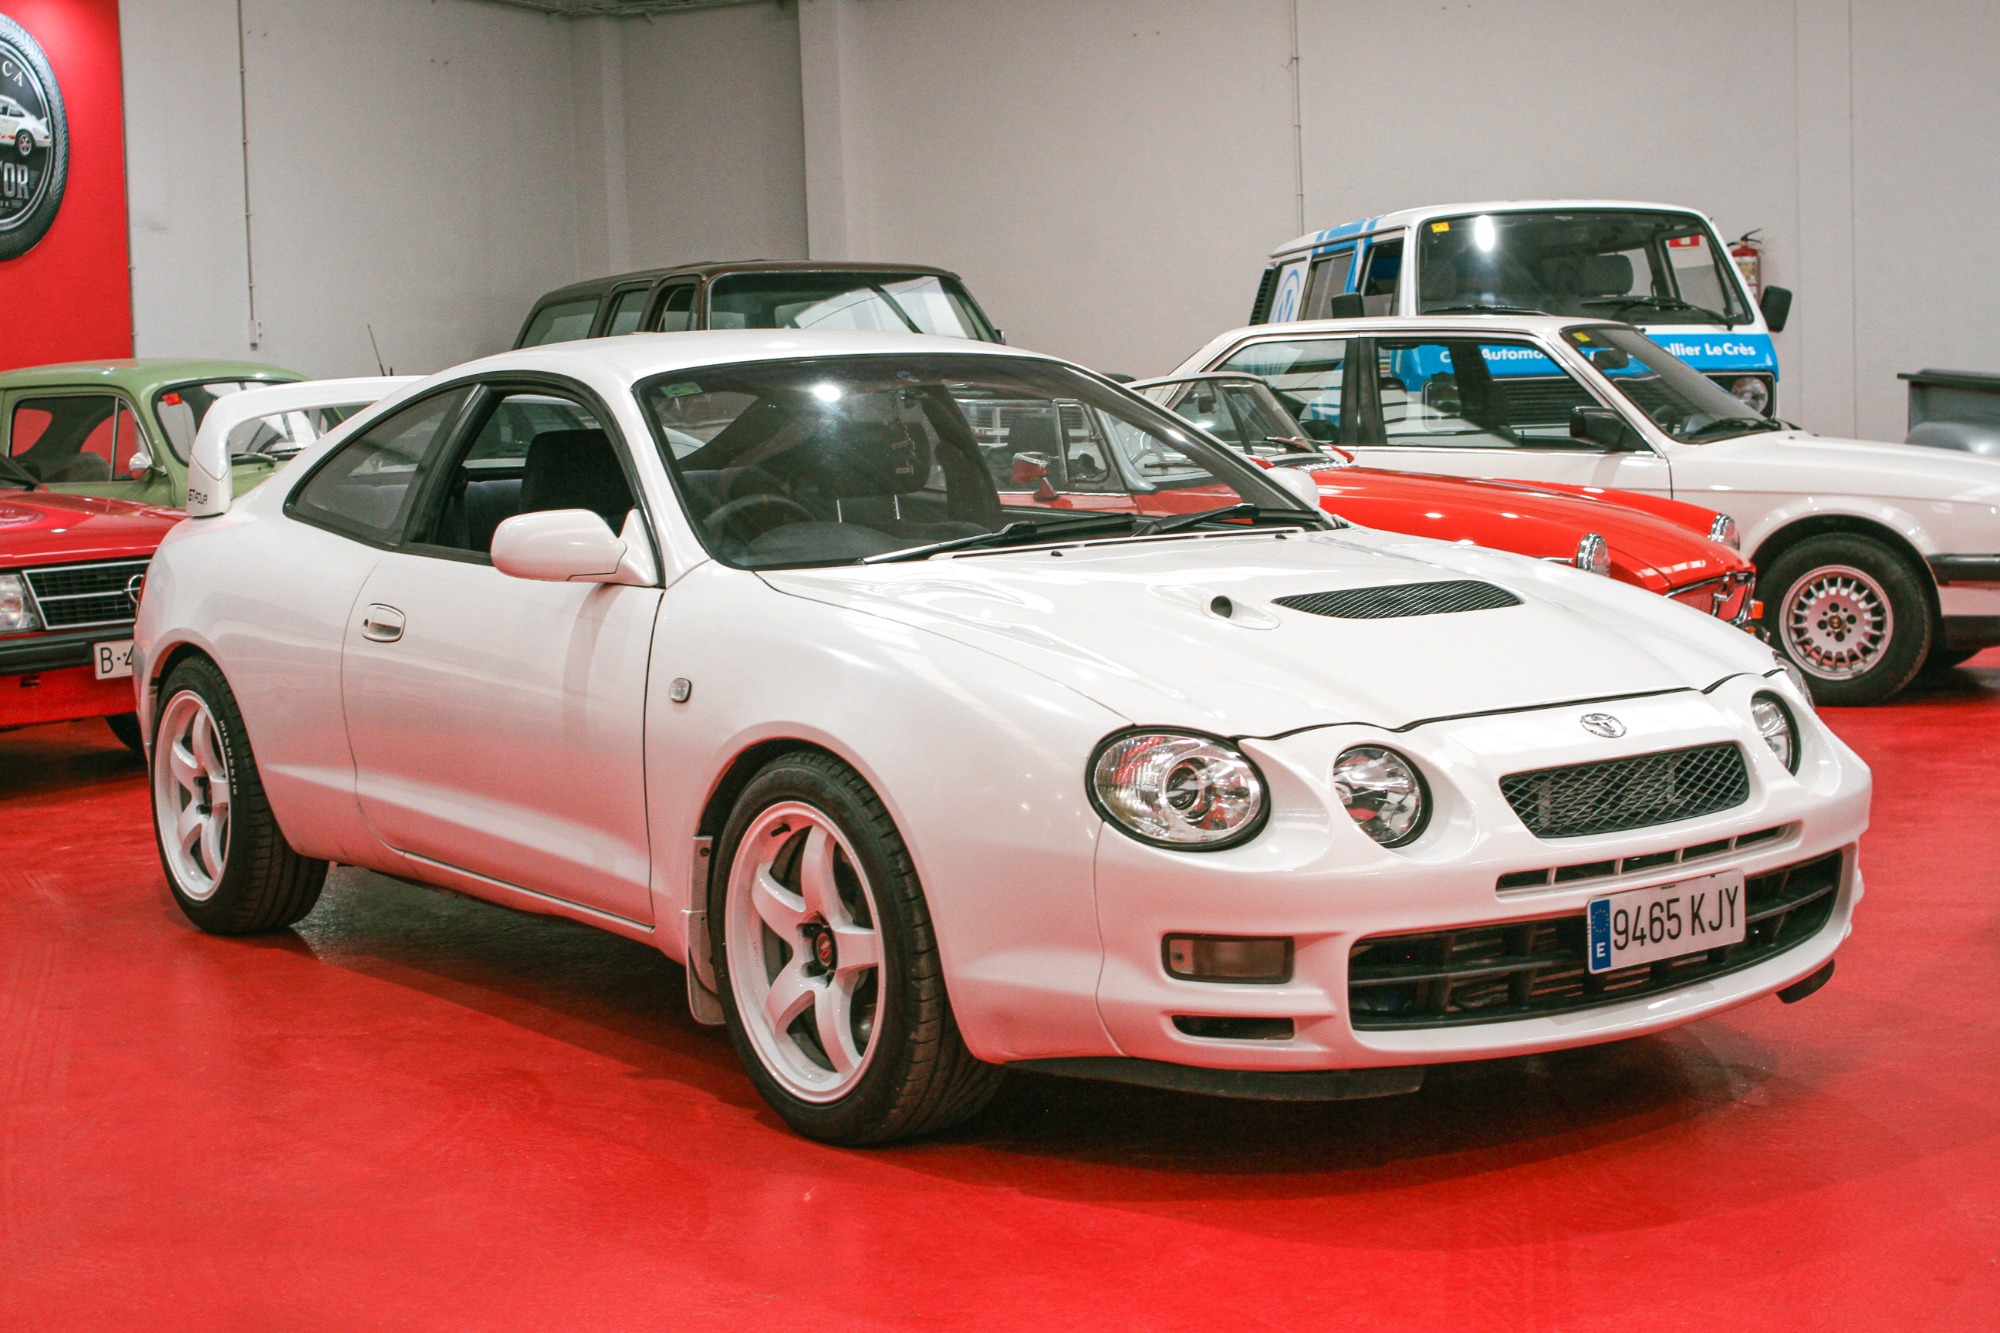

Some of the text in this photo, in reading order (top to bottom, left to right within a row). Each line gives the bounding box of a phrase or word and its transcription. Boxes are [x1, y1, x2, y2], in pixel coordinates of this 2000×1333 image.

[1481, 348, 1547, 360] Automo
[1613, 897, 1682, 951] 9465
[1691, 886, 1739, 936] KJY
[1596, 942, 1606, 958] E
